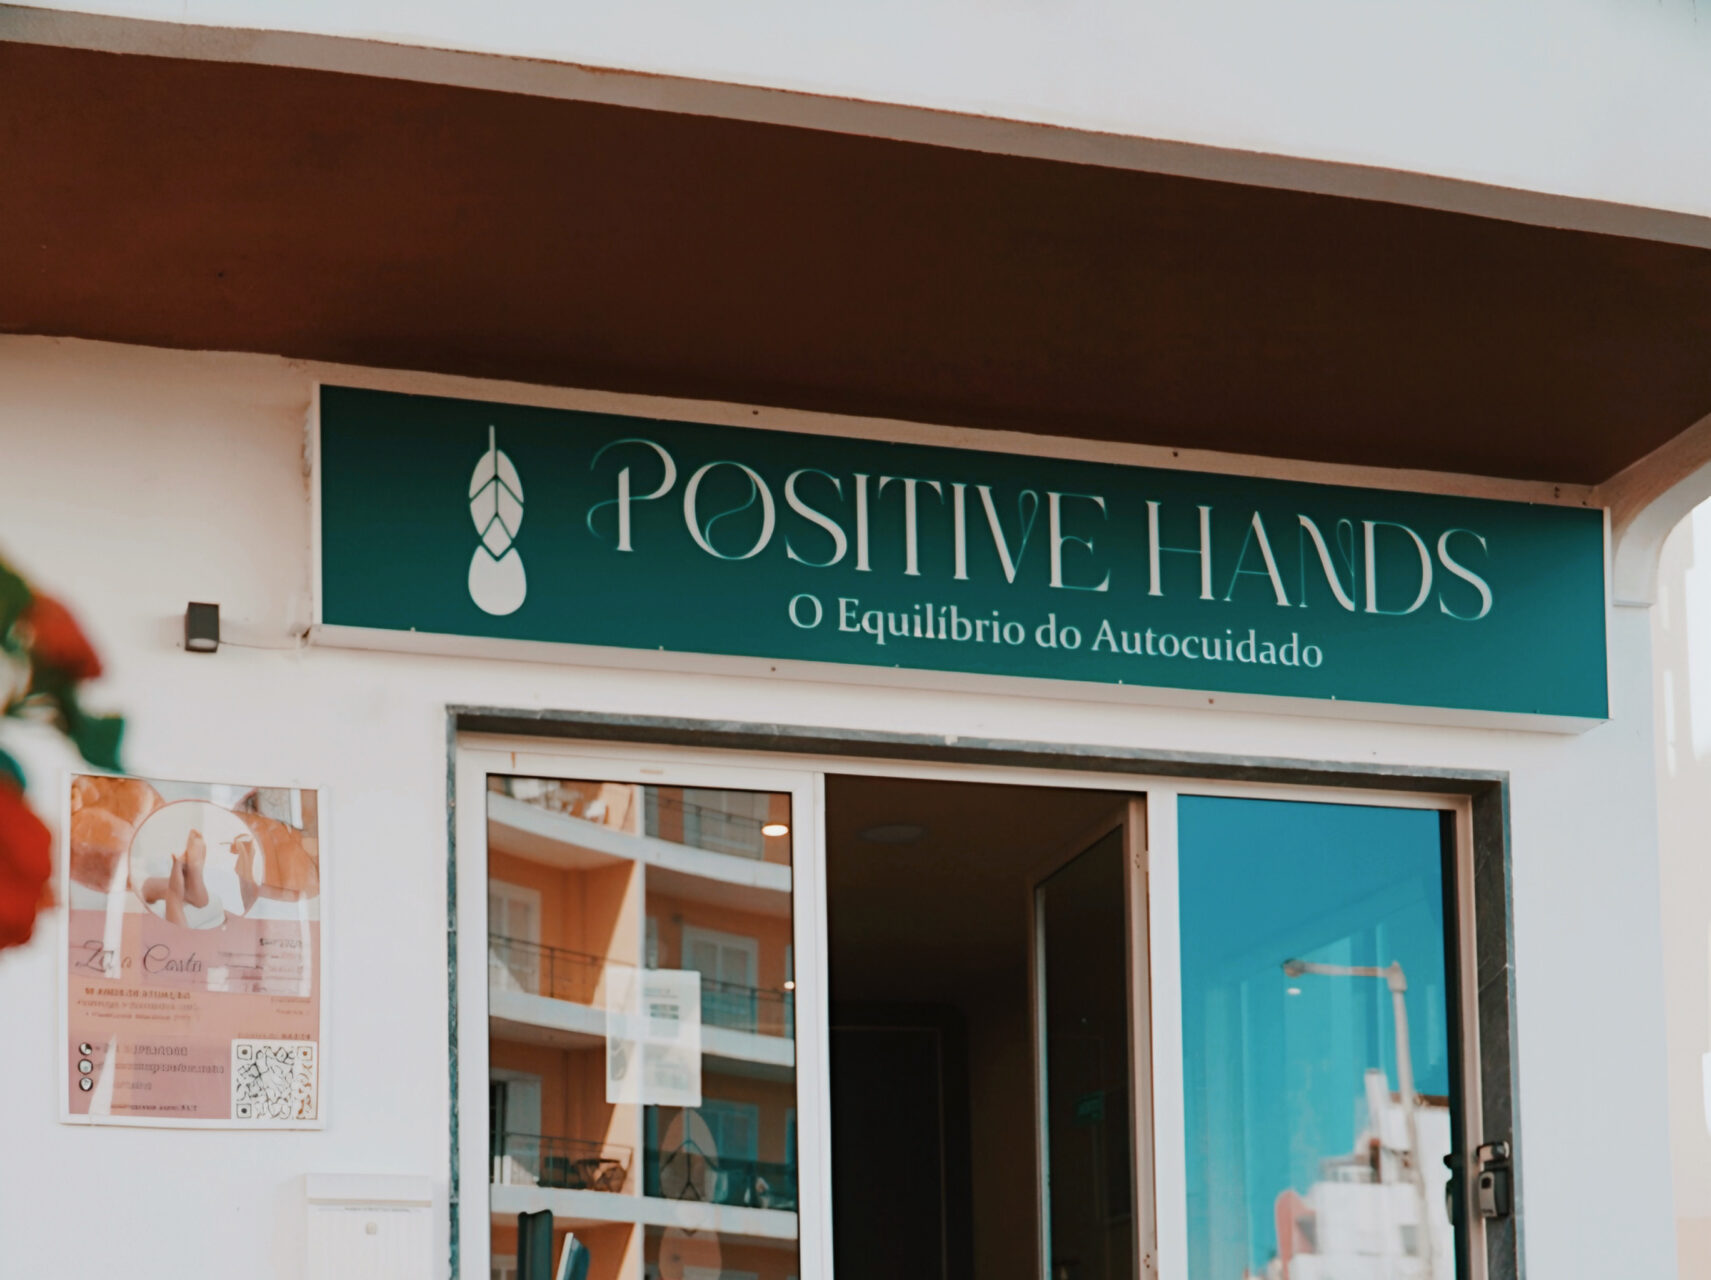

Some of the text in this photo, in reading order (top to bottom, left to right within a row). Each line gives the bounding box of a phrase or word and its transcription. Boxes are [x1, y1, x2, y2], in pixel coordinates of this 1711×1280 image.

[587, 437, 1494, 621] POSITIVE HANDS
[788, 593, 1323, 668] O Equilíbrio do Autocuidado
